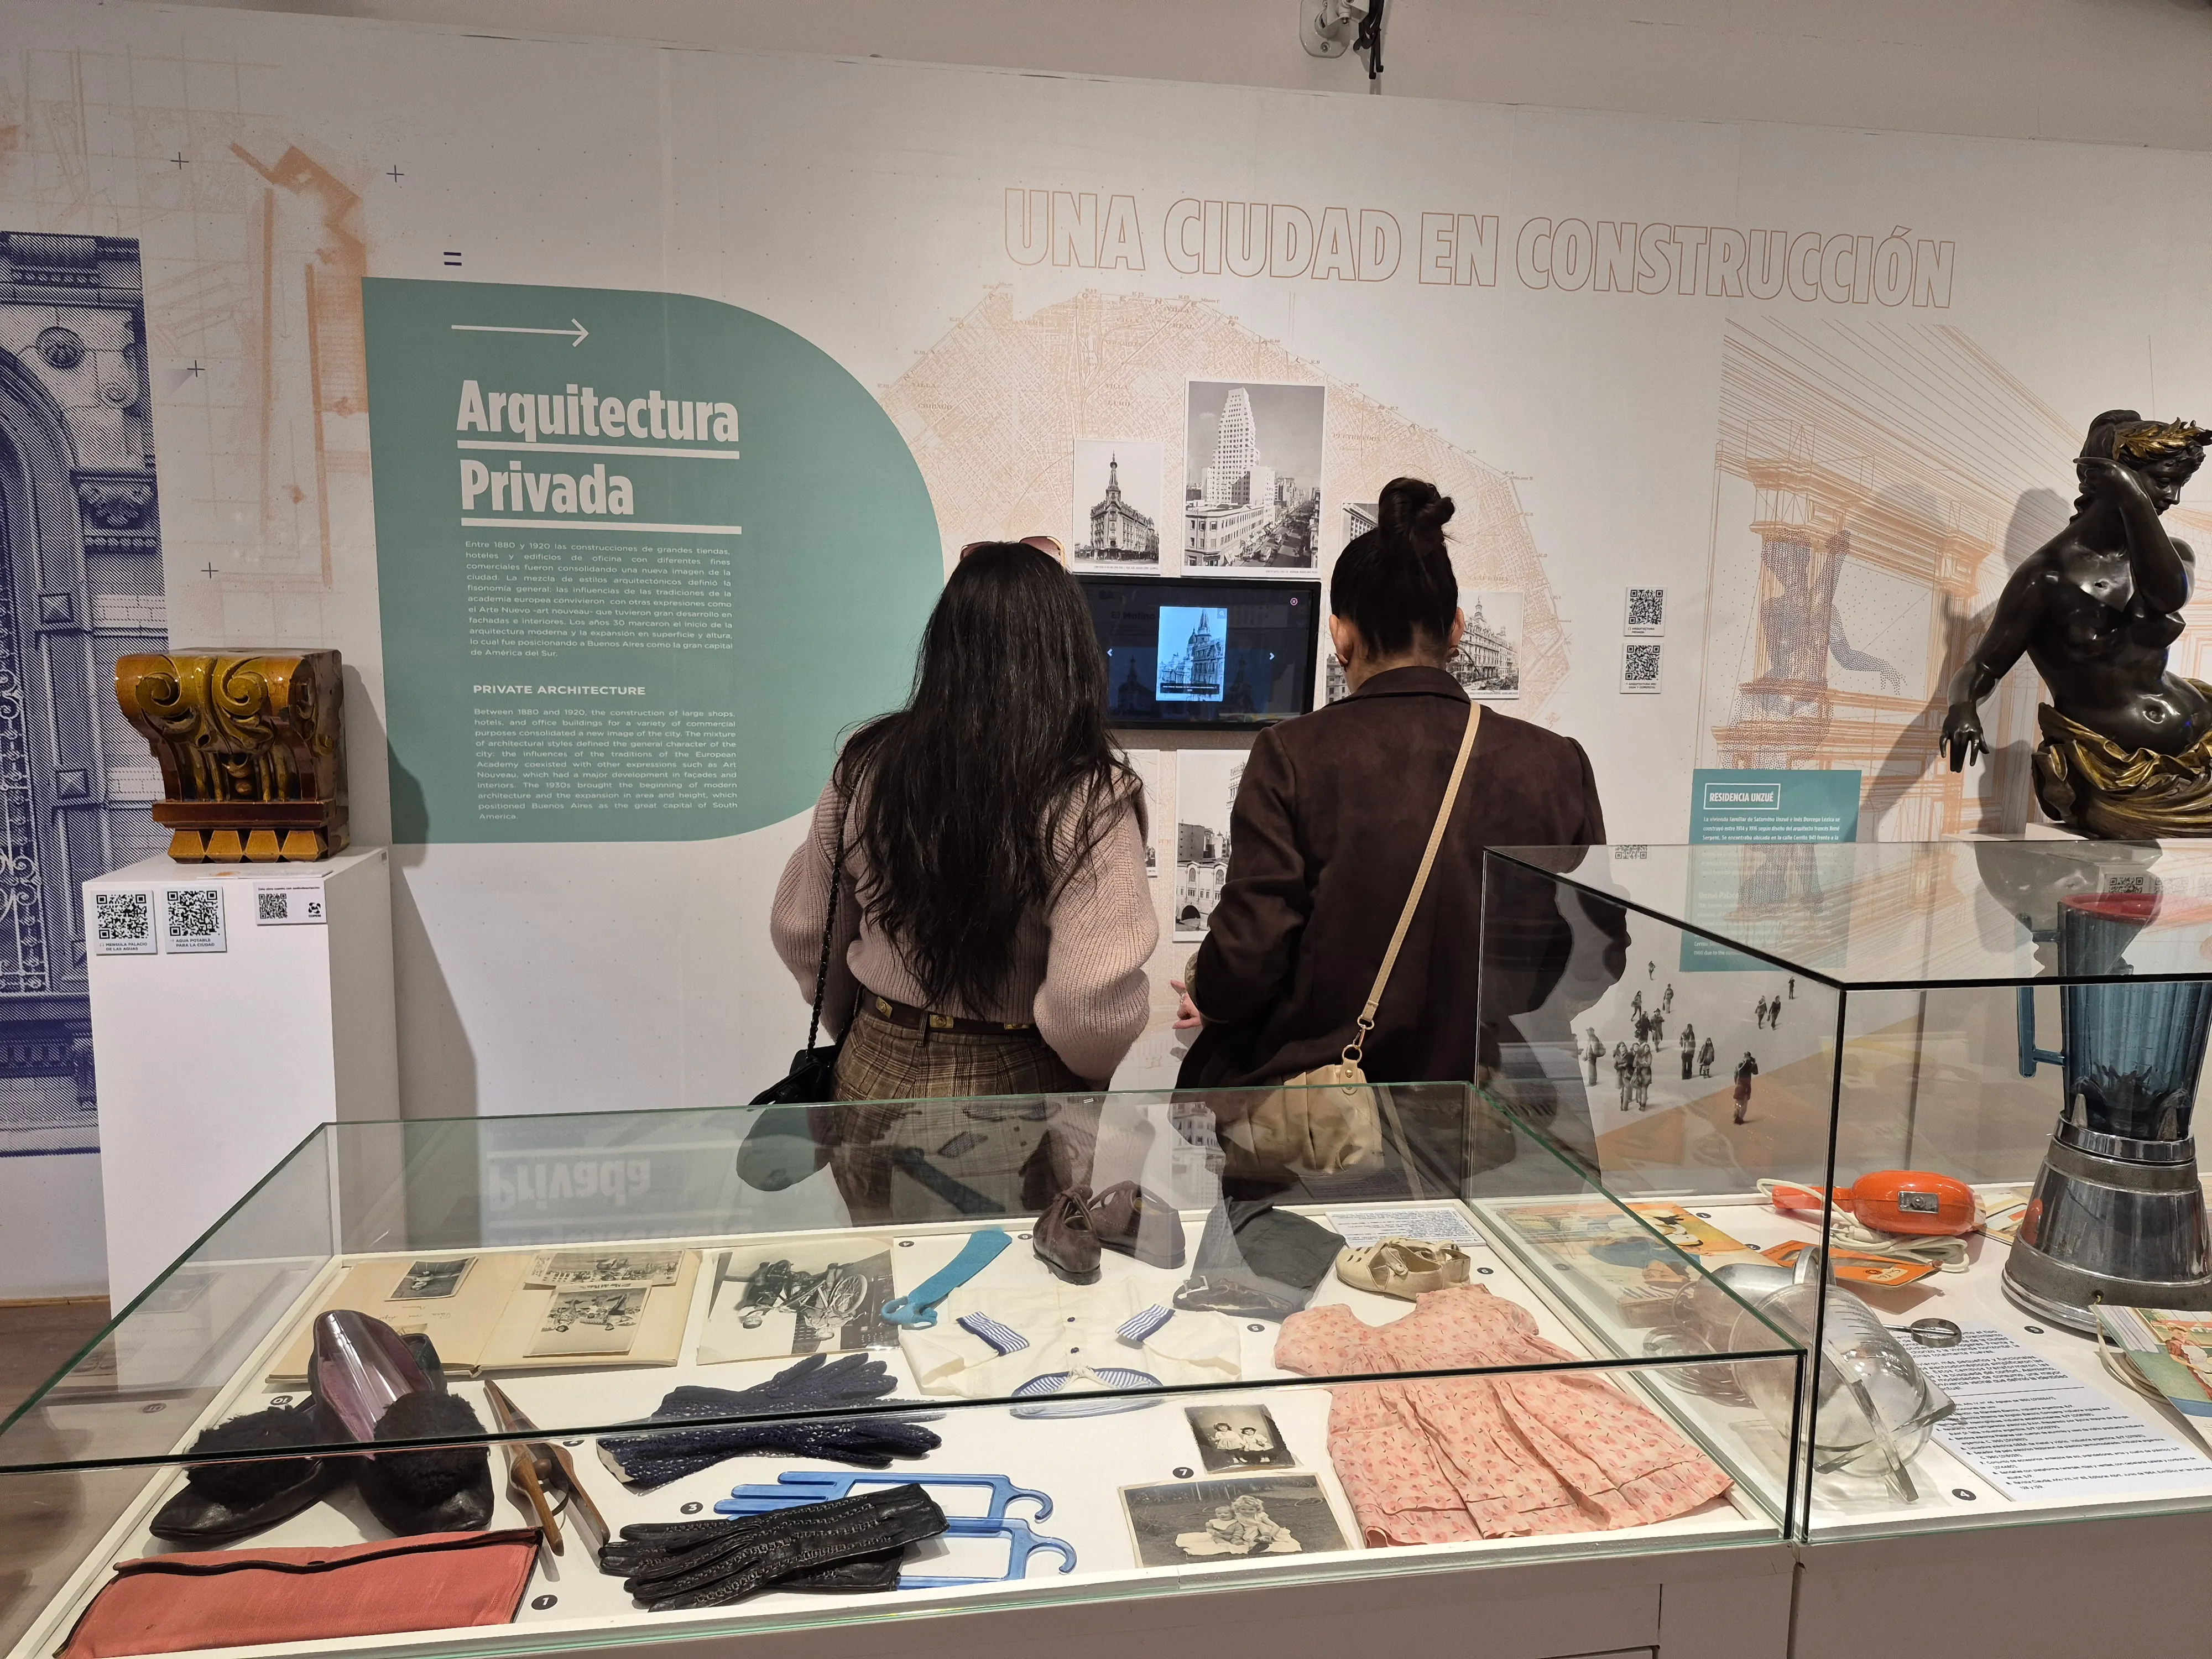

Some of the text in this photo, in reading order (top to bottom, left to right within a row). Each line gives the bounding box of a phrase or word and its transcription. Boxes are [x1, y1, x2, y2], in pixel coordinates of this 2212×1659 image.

[1005, 187, 1955, 309] UNA CIUDAD EN CONSTRUCCIÓN
[456, 379, 739, 442] Arquitectura
[460, 459, 634, 515] Privada
[571, 544, 638, 552] construcciones
[696, 546, 731, 556] tiendas,
[656, 556, 701, 565] diferentes
[709, 557, 731, 566] fines
[671, 567, 705, 576] imagen
[473, 685, 646, 695] PRIVATE ARCHITECTURE
[708, 709, 735, 718] shops,
[703, 731, 736, 739] mixture
[1709, 791, 1774, 802] RESIDENCIA UNZUÉ
